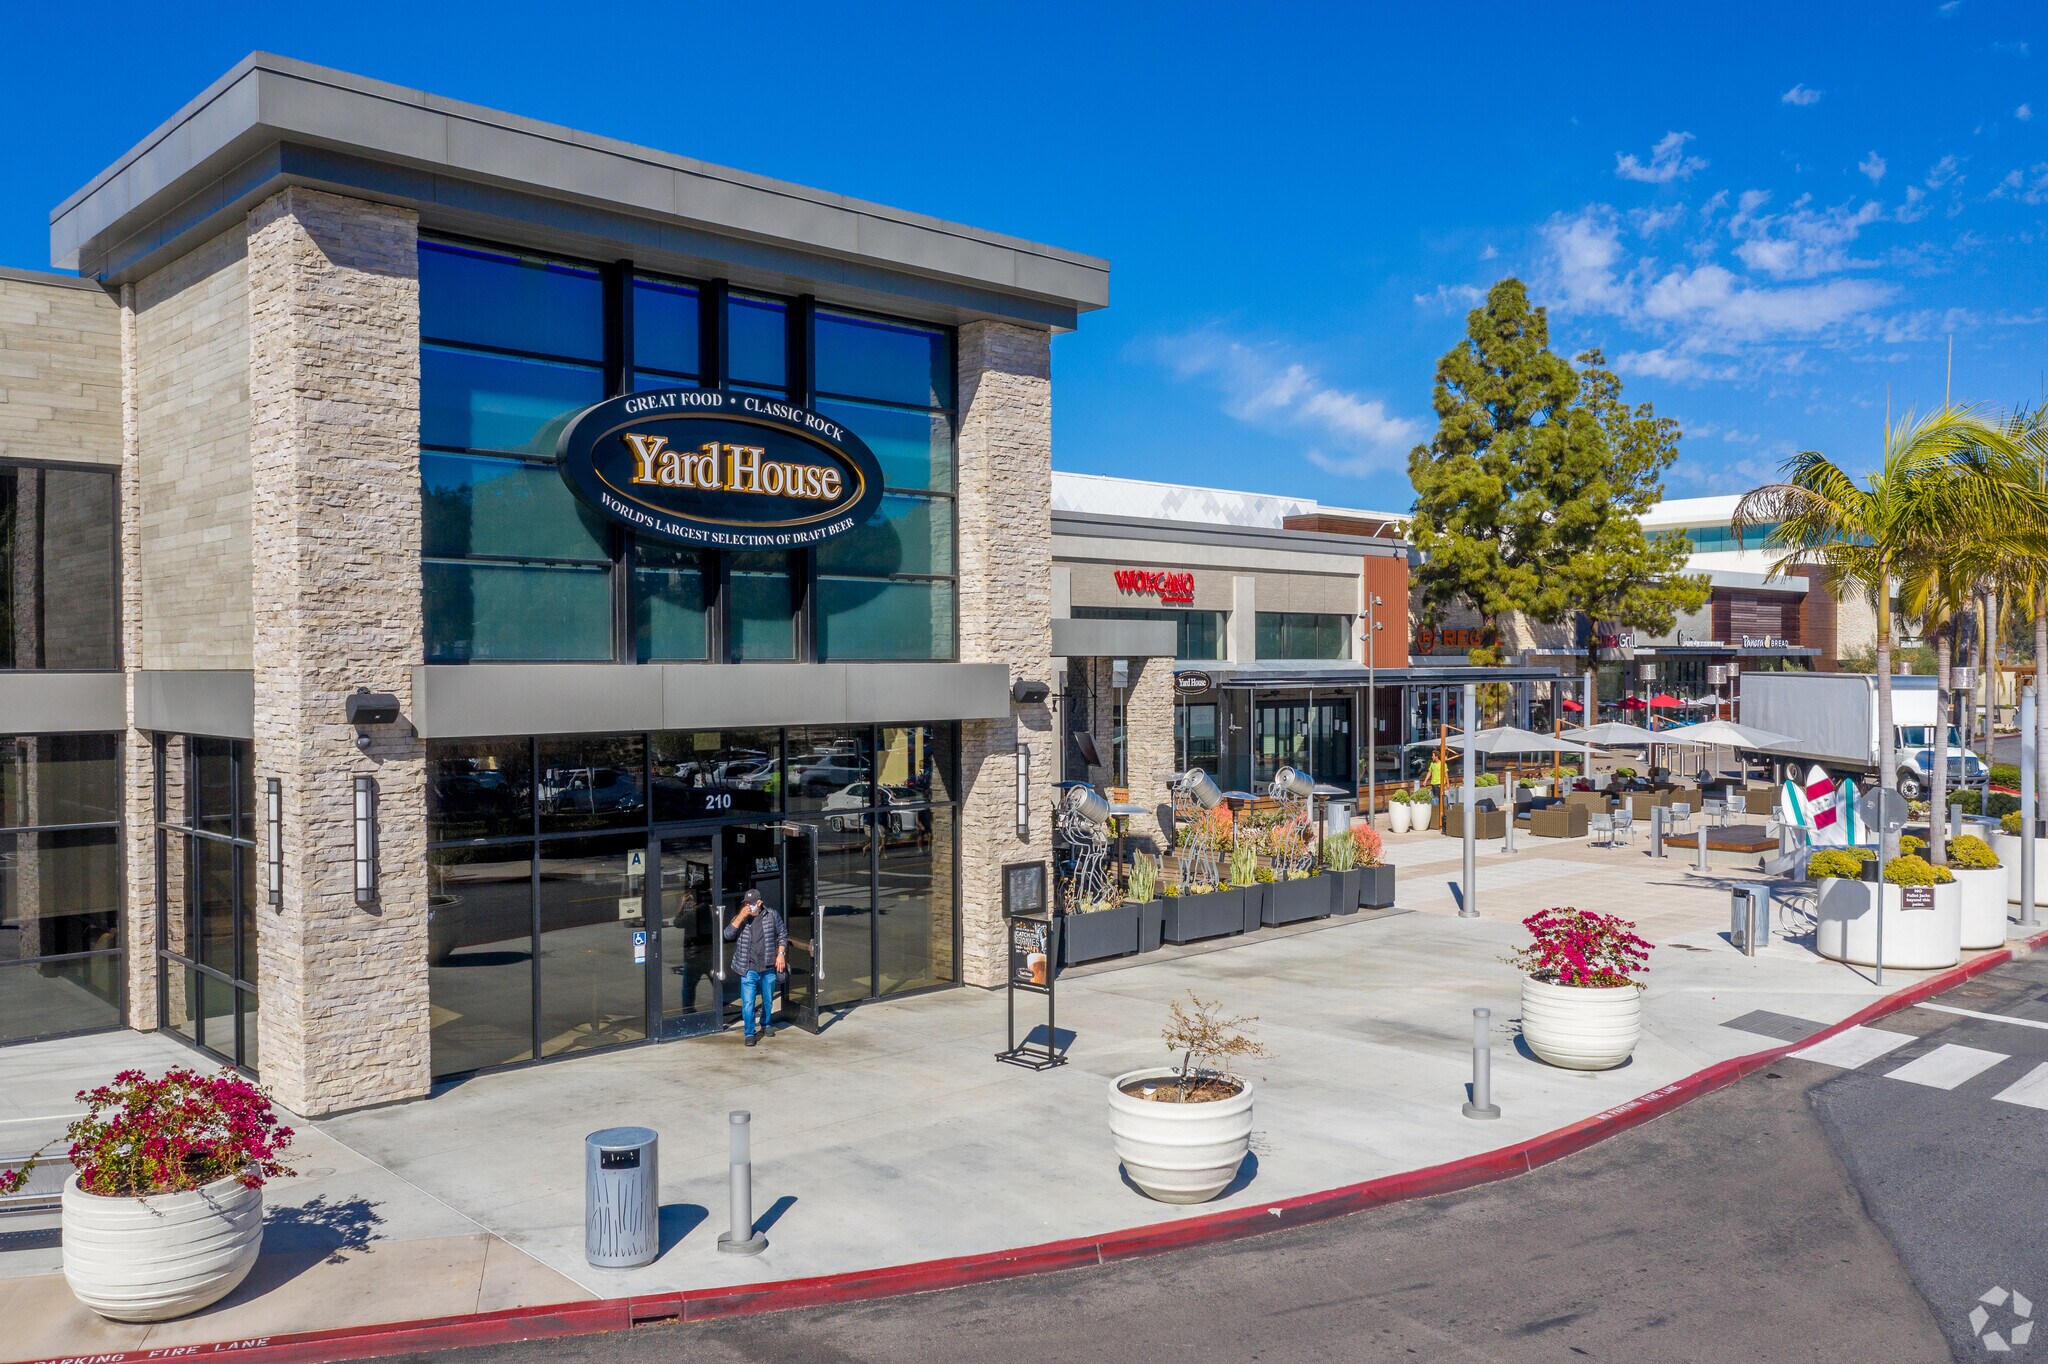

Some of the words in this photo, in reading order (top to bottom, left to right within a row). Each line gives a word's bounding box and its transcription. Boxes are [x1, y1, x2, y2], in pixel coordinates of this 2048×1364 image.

[625, 393, 677, 414] GREAT
[681, 392, 723, 406] FOOD
[744, 397, 803, 422] CLASSIC
[805, 413, 844, 442] ROCK
[625, 432, 722, 489] Yard
[723, 444, 843, 500] House
[601, 492, 654, 527] WORLD'S
[655, 519, 710, 541] LARGEST
[711, 532, 774, 546] SELECTION
[776, 534, 791, 545] OF
[793, 527, 826, 543] DRAFT
[828, 517, 855, 535] BEER
[1442, 630, 1505, 646] REGL
[1178, 678, 1191, 686] Yard
[1191, 678, 1206, 686] House
[706, 794, 731, 809] 210
[632, 853, 641, 865] A
[148, 1345, 201, 1358] FIRE
[213, 1337, 271, 1352] LANE
